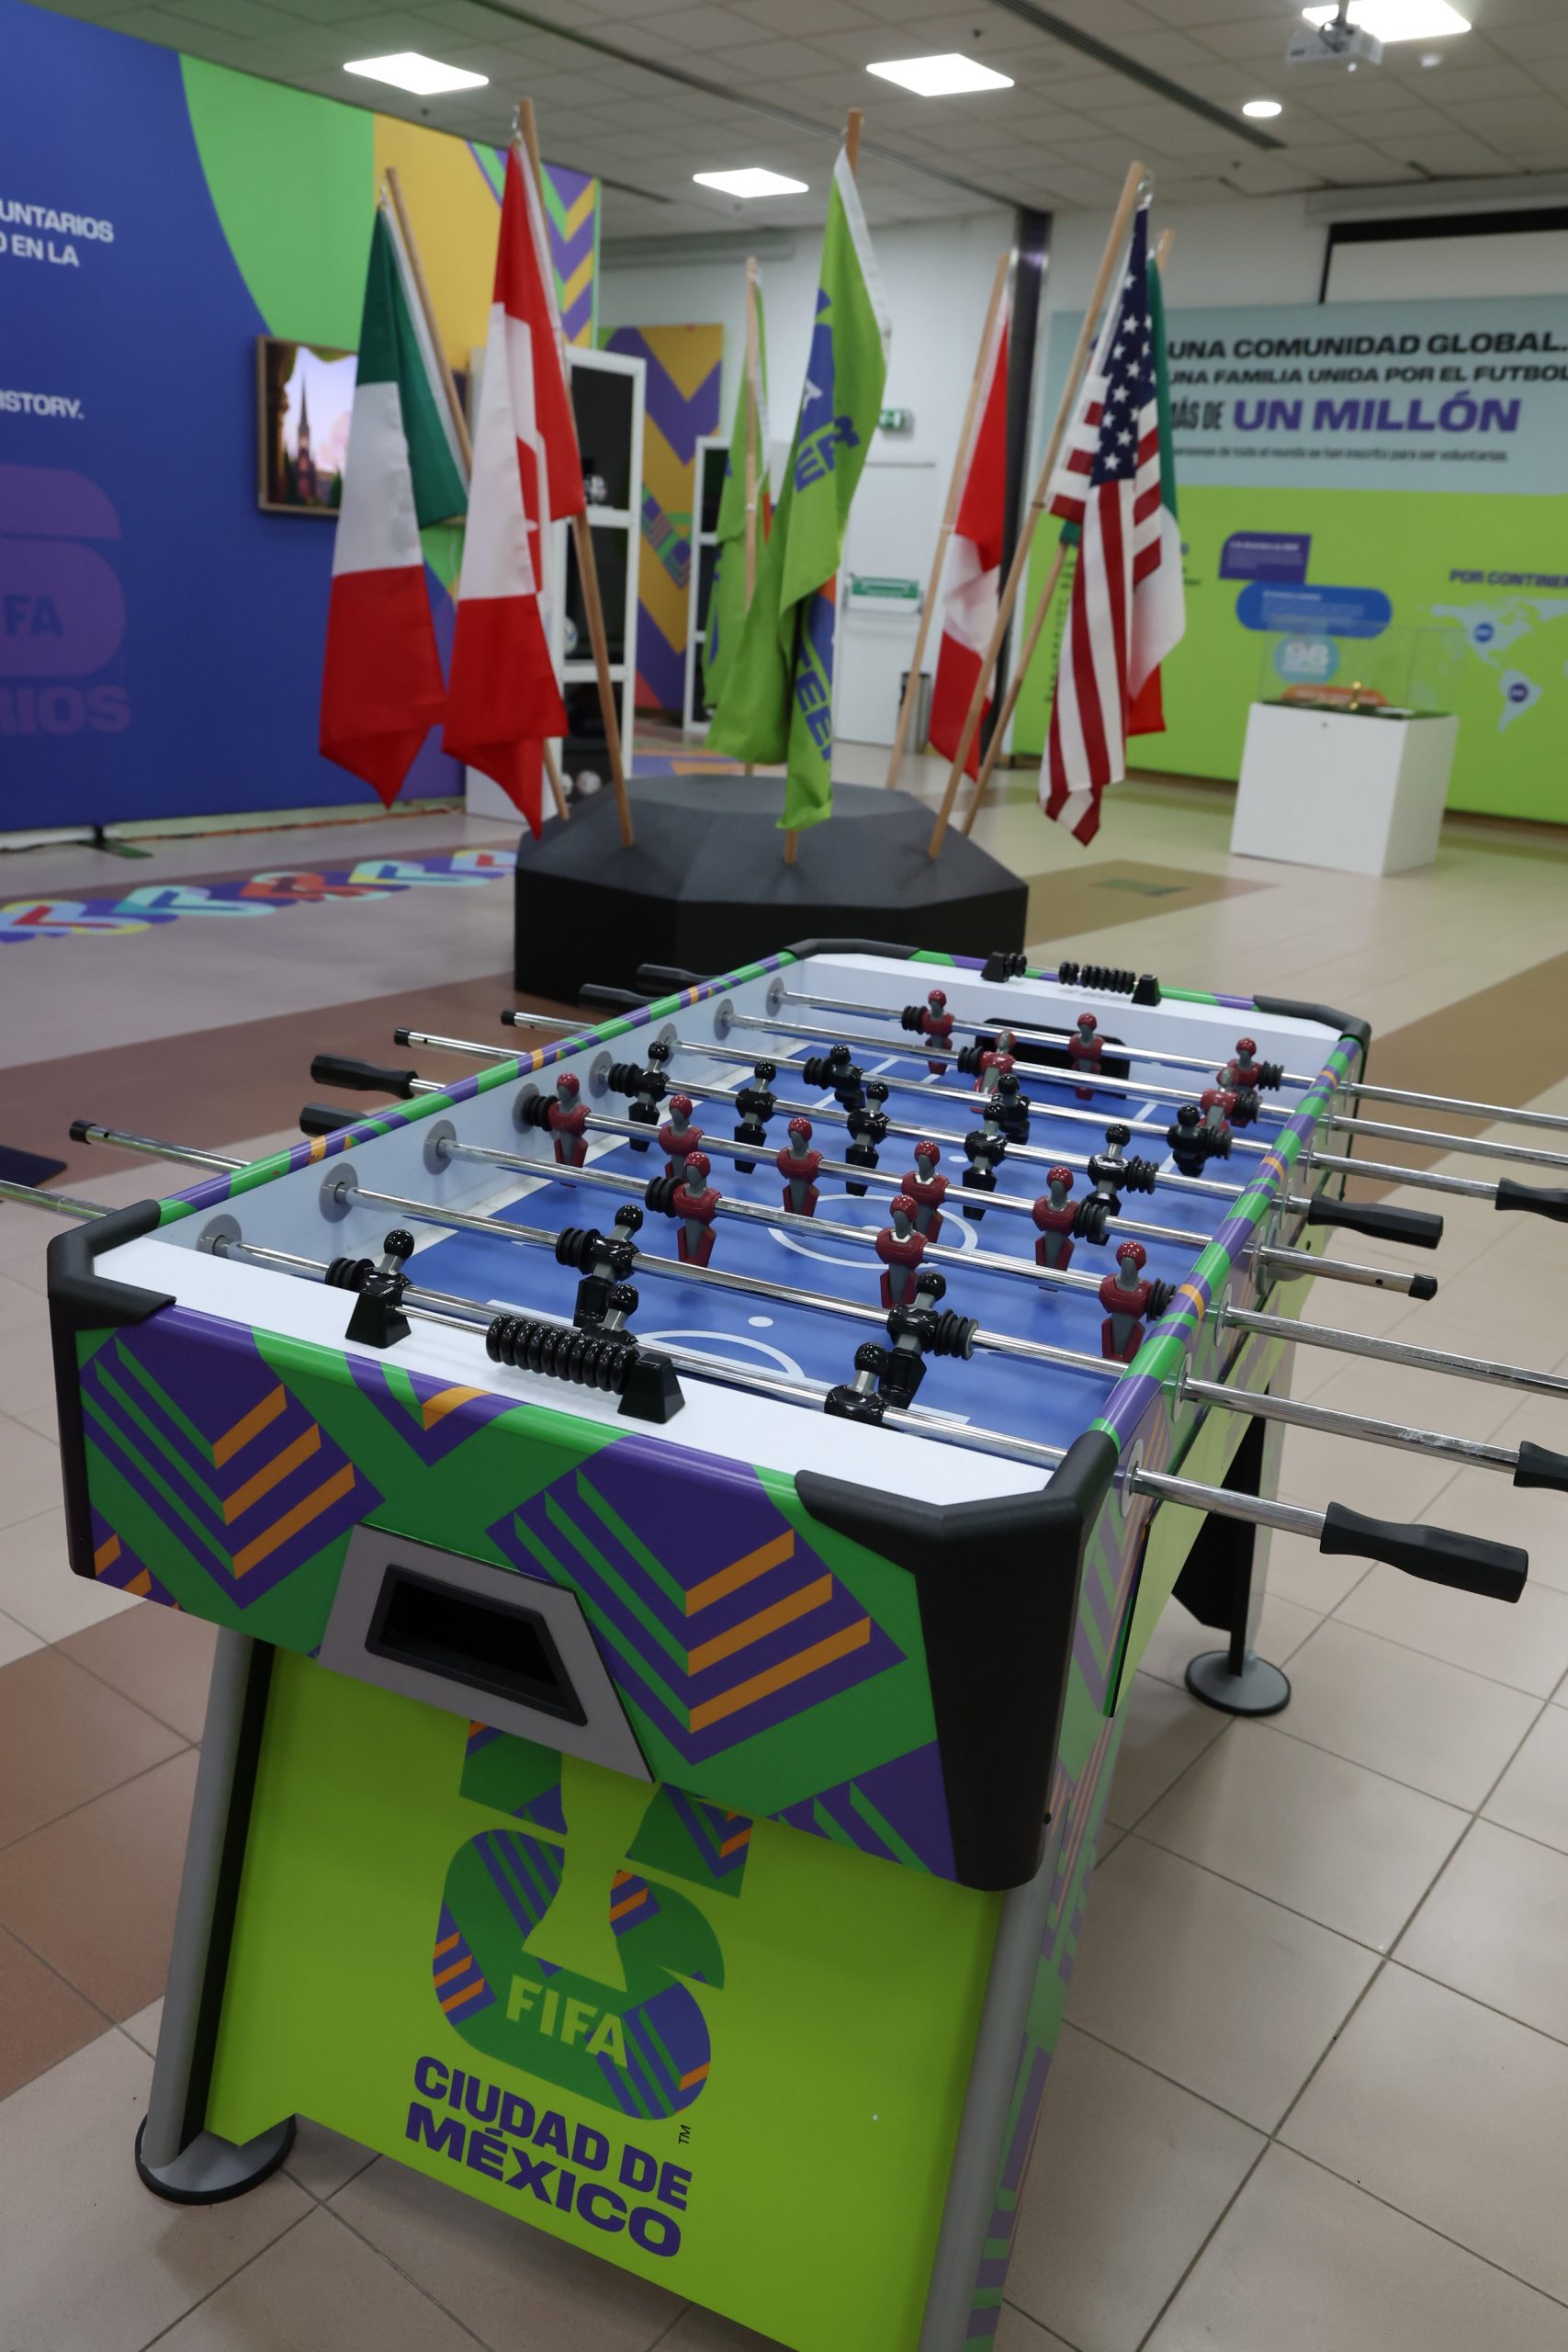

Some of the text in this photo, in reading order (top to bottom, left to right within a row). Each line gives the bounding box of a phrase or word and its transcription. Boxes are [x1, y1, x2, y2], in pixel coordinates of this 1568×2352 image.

[12, 234, 43, 260] EN
[48, 241, 80, 266] LA
[1168, 341, 1226, 359] UNA
[1234, 335, 1420, 357] COMUNIDAD
[1213, 367, 1303, 384] FAMILIA
[1308, 367, 1379, 384] UNIDA
[1385, 367, 1435, 383] POR
[1439, 366, 1468, 382] EL
[1234, 399, 1303, 431] UN
[1312, 390, 1522, 433] MILLÓN
[1449, 570, 1484, 584] POR
[506, 1974, 628, 2068] FIFA
[413, 2056, 693, 2211] CIUDAD DE
[405, 2101, 682, 2257] MÉXICO
